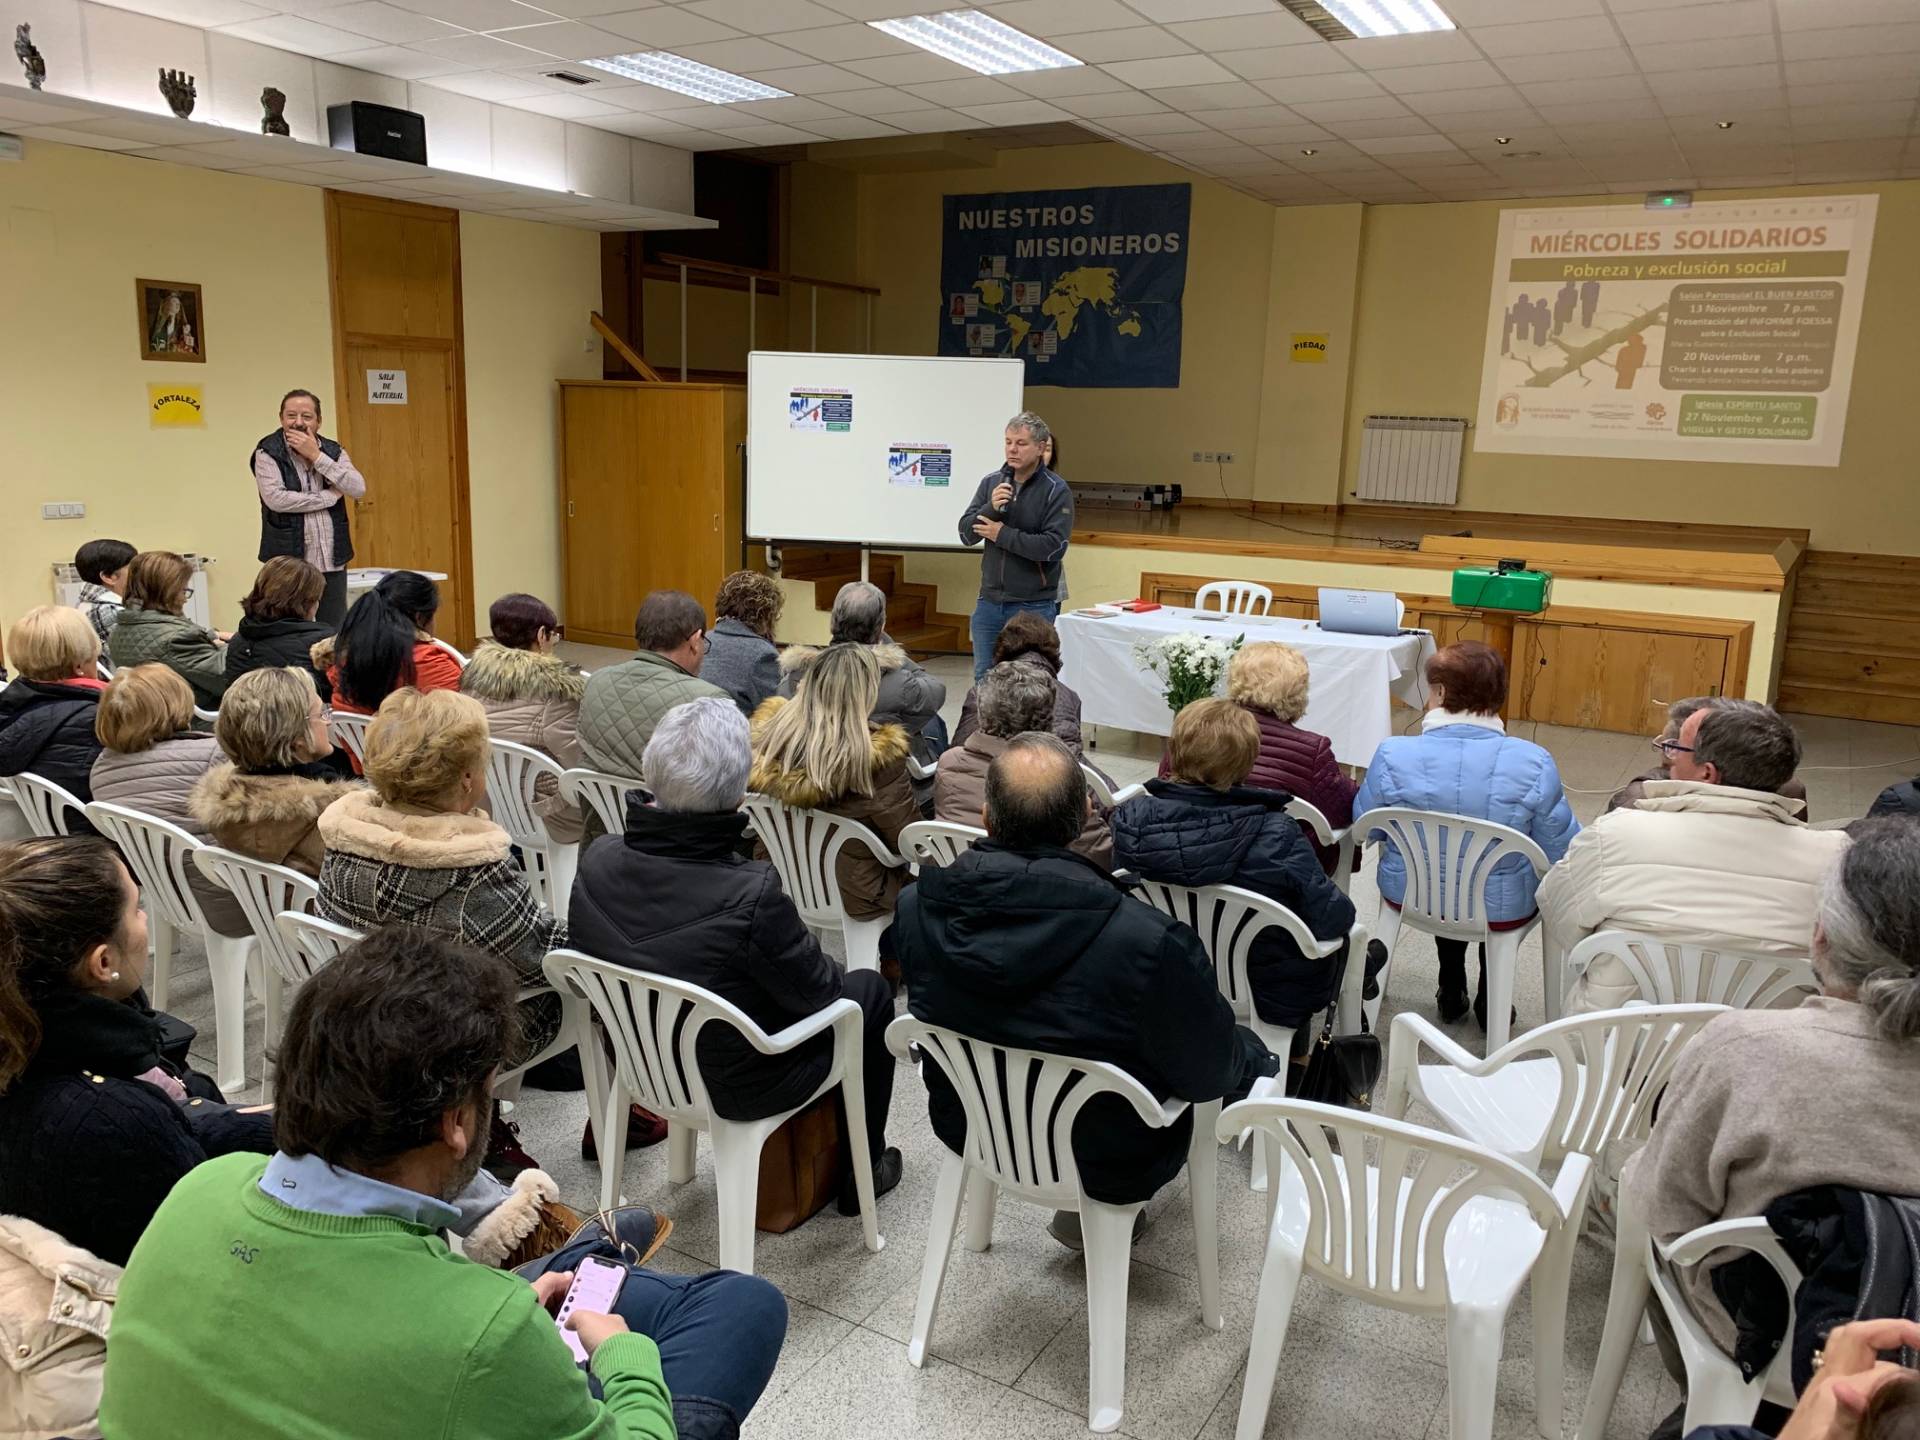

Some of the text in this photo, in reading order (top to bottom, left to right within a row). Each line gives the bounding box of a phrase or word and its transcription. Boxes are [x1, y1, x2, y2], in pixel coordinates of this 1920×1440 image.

[958, 204, 1095, 230] NUESTROS
[1015, 232, 1180, 258] MISIONEROS
[1530, 226, 1828, 254] MIÉRCOLES SOLIDARIOS
[1563, 259, 1788, 279] Pobreza y exclusión social
[1754, 290, 1766, 299] EL
[1767, 290, 1794, 299] BUEN
[1705, 304, 1768, 313] Noviembre
[1783, 303, 1790, 313] 7
[1792, 304, 1819, 314] p.m.
[1683, 352, 1812, 364] 20 Noviembre 7 p.m.
[153, 394, 201, 412] FORTALEZA
[1685, 412, 1698, 421] 27
[1701, 413, 1764, 423] Noviembre
[1772, 414, 1780, 424] 7
